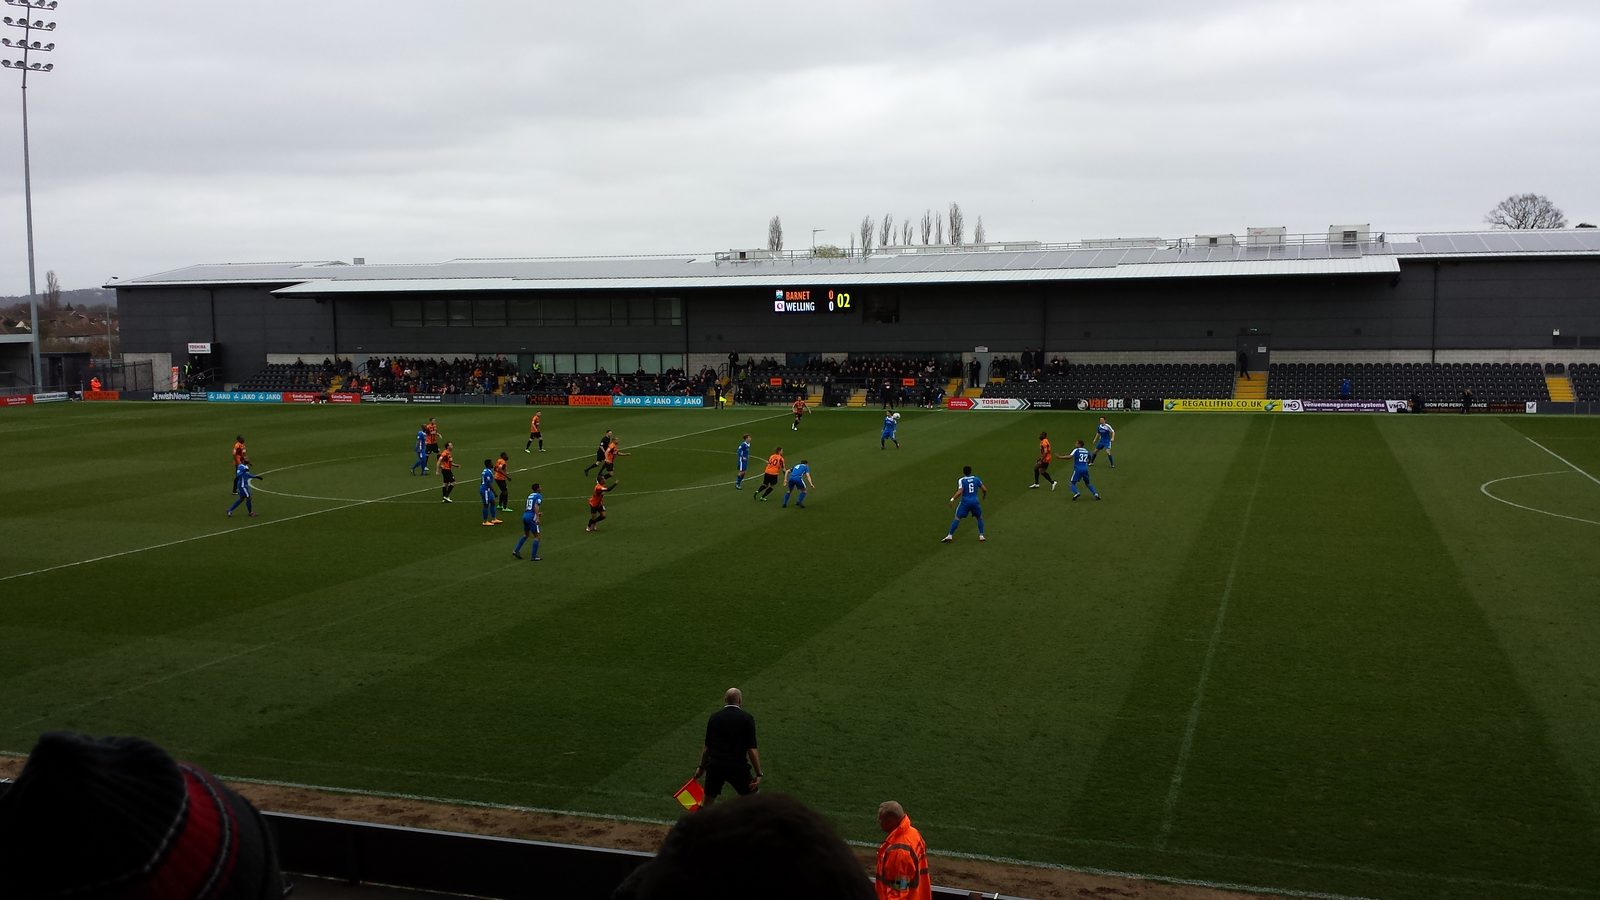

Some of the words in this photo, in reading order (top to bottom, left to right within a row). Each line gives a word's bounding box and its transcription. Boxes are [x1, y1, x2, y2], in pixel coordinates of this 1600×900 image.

[785, 291, 811, 301] BARNET
[828, 290, 834, 300] 0
[836, 293, 851, 308] 02
[785, 302, 815, 312] WELLING
[828, 301, 834, 312] 0
[1088, 398, 1140, 408] vanaraa
[1078, 453, 1089, 463] 32
[968, 482, 975, 493] 6
[525, 498, 534, 511] 19
